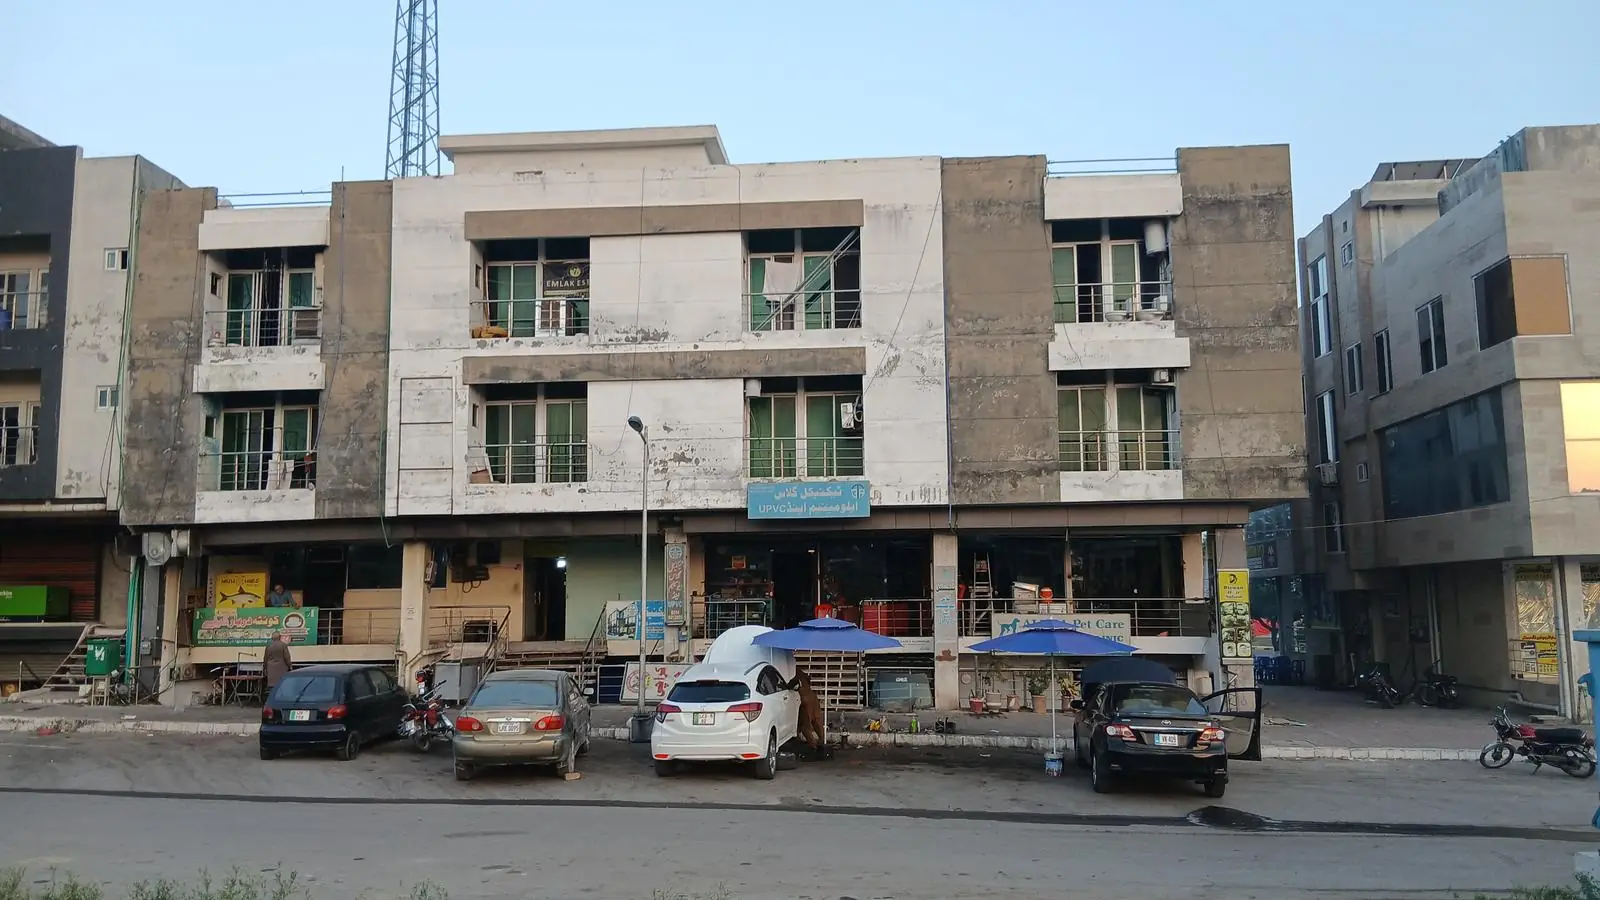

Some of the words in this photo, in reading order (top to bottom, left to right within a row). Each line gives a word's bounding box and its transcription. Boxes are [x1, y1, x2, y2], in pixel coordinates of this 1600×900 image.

[546, 280, 575, 288] EMLAK
[759, 504, 786, 513] UPVC
[1074, 619, 1091, 629] Pet
[1096, 619, 1125, 629] Care
